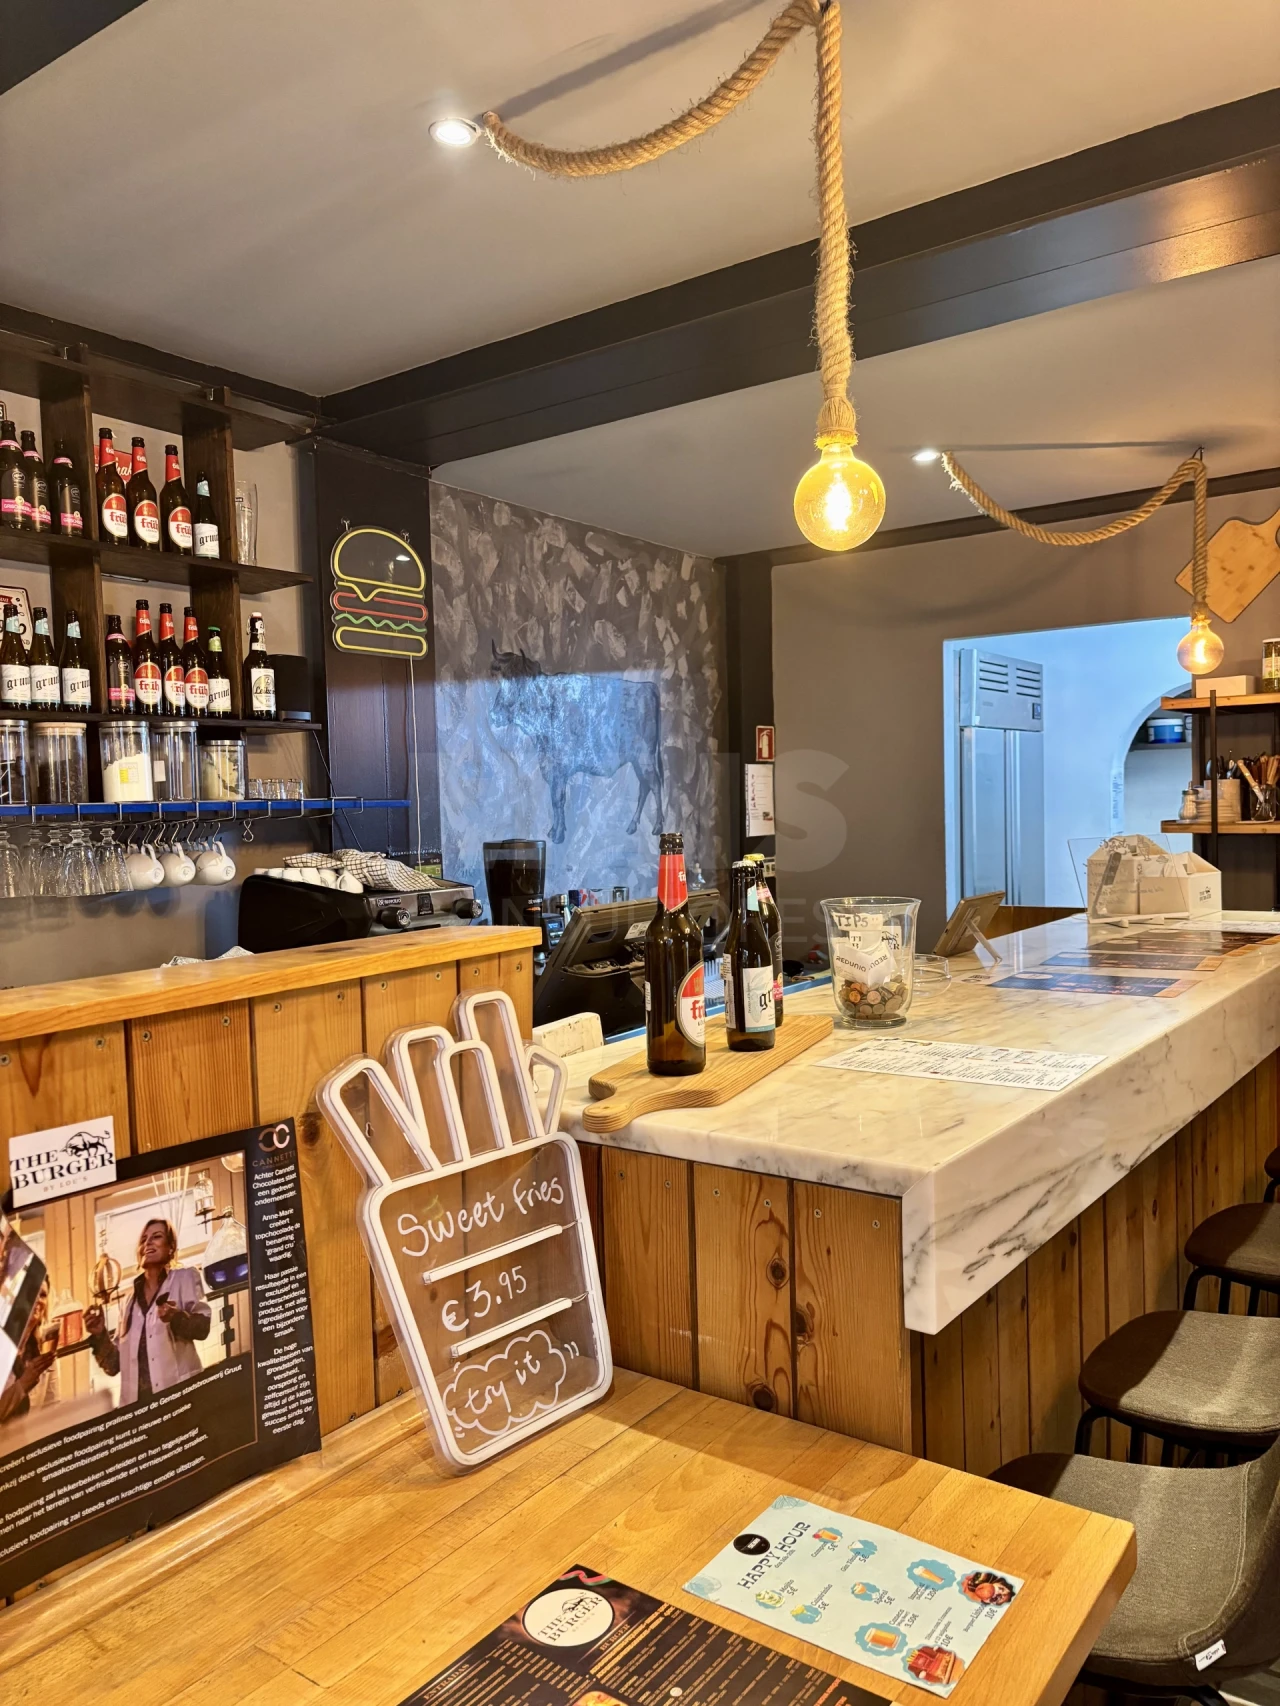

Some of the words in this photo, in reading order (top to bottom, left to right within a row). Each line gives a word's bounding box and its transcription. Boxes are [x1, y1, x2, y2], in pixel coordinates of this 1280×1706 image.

[14, 1150, 58, 1172] THE
[13, 1152, 116, 1190] BURGER
[254, 1171, 274, 1180] Achter
[285, 1172, 297, 1180] staat
[397, 1191, 505, 1257] Sweet
[266, 1234, 294, 1246] benaming
[255, 1277, 289, 1291] resulteerde
[296, 1271, 306, 1279] een
[281, 1266, 298, 1277] passie
[259, 1288, 305, 1307] onderscheidend
[265, 1284, 290, 1297] exclusief
[285, 1301, 295, 1309] met
[276, 1314, 305, 1329] bijzondere
[284, 1342, 297, 1352] hoge
[264, 1385, 298, 1400] zelfcensuur
[300, 1381, 310, 1389] zijn
[267, 1377, 297, 1391] oorsprong
[464, 1380, 512, 1415] try
[514, 1351, 541, 1385] it
[262, 1406, 288, 1420] geweest
[289, 1402, 299, 1410] van
[300, 1396, 314, 1405] haar
[264, 1400, 280, 1410] altijd
[288, 1394, 295, 1402] de
[26, 1440, 62, 1460] exclusieve
[63, 1423, 104, 1444] foodpairing
[106, 1412, 133, 1430] pralines
[134, 1406, 148, 1416] voor
[150, 1402, 158, 1410] de
[160, 1392, 182, 1406] Gentse
[182, 1371, 224, 1396] stadsbrouwerij
[224, 1364, 242, 1376] Gruut
[264, 1416, 287, 1427] succes
[288, 1408, 303, 1419] sinds
[273, 1423, 292, 1434] eerste
[18, 1470, 35, 1482] deze
[36, 1454, 72, 1474] exclusieve
[74, 1436, 114, 1458] foodpairing
[115, 1430, 131, 1440] kunt
[138, 1418, 162, 1431] nieuwe
[162, 1412, 172, 1422] en
[172, 1403, 192, 1416] unieke
[5, 1496, 44, 1522] foodpairing
[46, 1491, 56, 1502] zal
[57, 1470, 104, 1496] lekkerbekken
[105, 1457, 137, 1475] verleiden
[138, 1452, 147, 1461] en
[148, 1446, 161, 1456] hen
[162, 1427, 199, 1450] tegelijkertijd
[42, 1450, 109, 1482] smaakcombinaties
[16, 1514, 32, 1528] naar
[33, 1508, 45, 1518] het
[46, 1496, 70, 1512] terrein
[70, 1490, 85, 1501] van
[85, 1471, 128, 1494] verfrissende
[128, 1466, 138, 1476] en
[139, 1446, 183, 1471] vernieuwende
[29, 1518, 70, 1542] foodpairing
[70, 1512, 80, 1522] zal
[82, 1501, 105, 1517] steeds
[106, 1495, 120, 1506] een
[120, 1481, 152, 1500] krachtige
[154, 1469, 176, 1485] emotie
[737, 1551, 780, 1589] HAPPY
[774, 1522, 811, 1552] HOUR
[780, 1579, 794, 1593] Mojito
[548, 1596, 604, 1642] BURGER
[984, 1607, 998, 1620] 10€
[538, 1614, 566, 1637] THE
[941, 1634, 953, 1647] 10€
